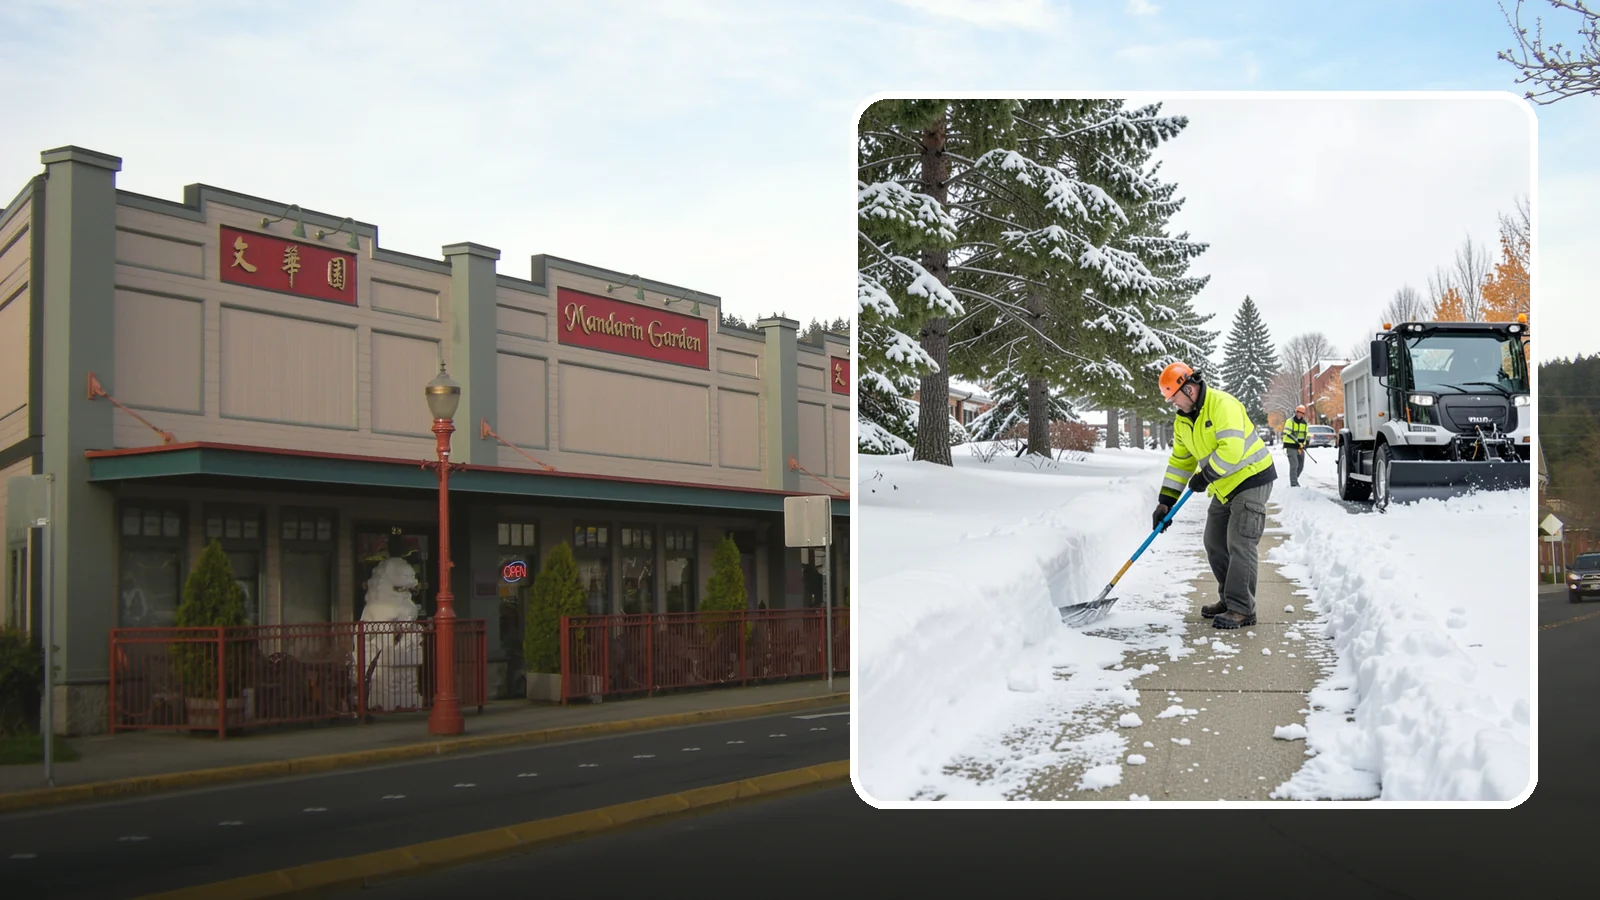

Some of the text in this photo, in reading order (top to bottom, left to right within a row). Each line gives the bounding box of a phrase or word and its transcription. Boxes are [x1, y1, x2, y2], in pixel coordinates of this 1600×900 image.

[230, 235, 346, 291] 文華園
[564, 302, 701, 352] Mandarin Garden
[835, 363, 846, 386] 文
[503, 565, 527, 578] OPEN
